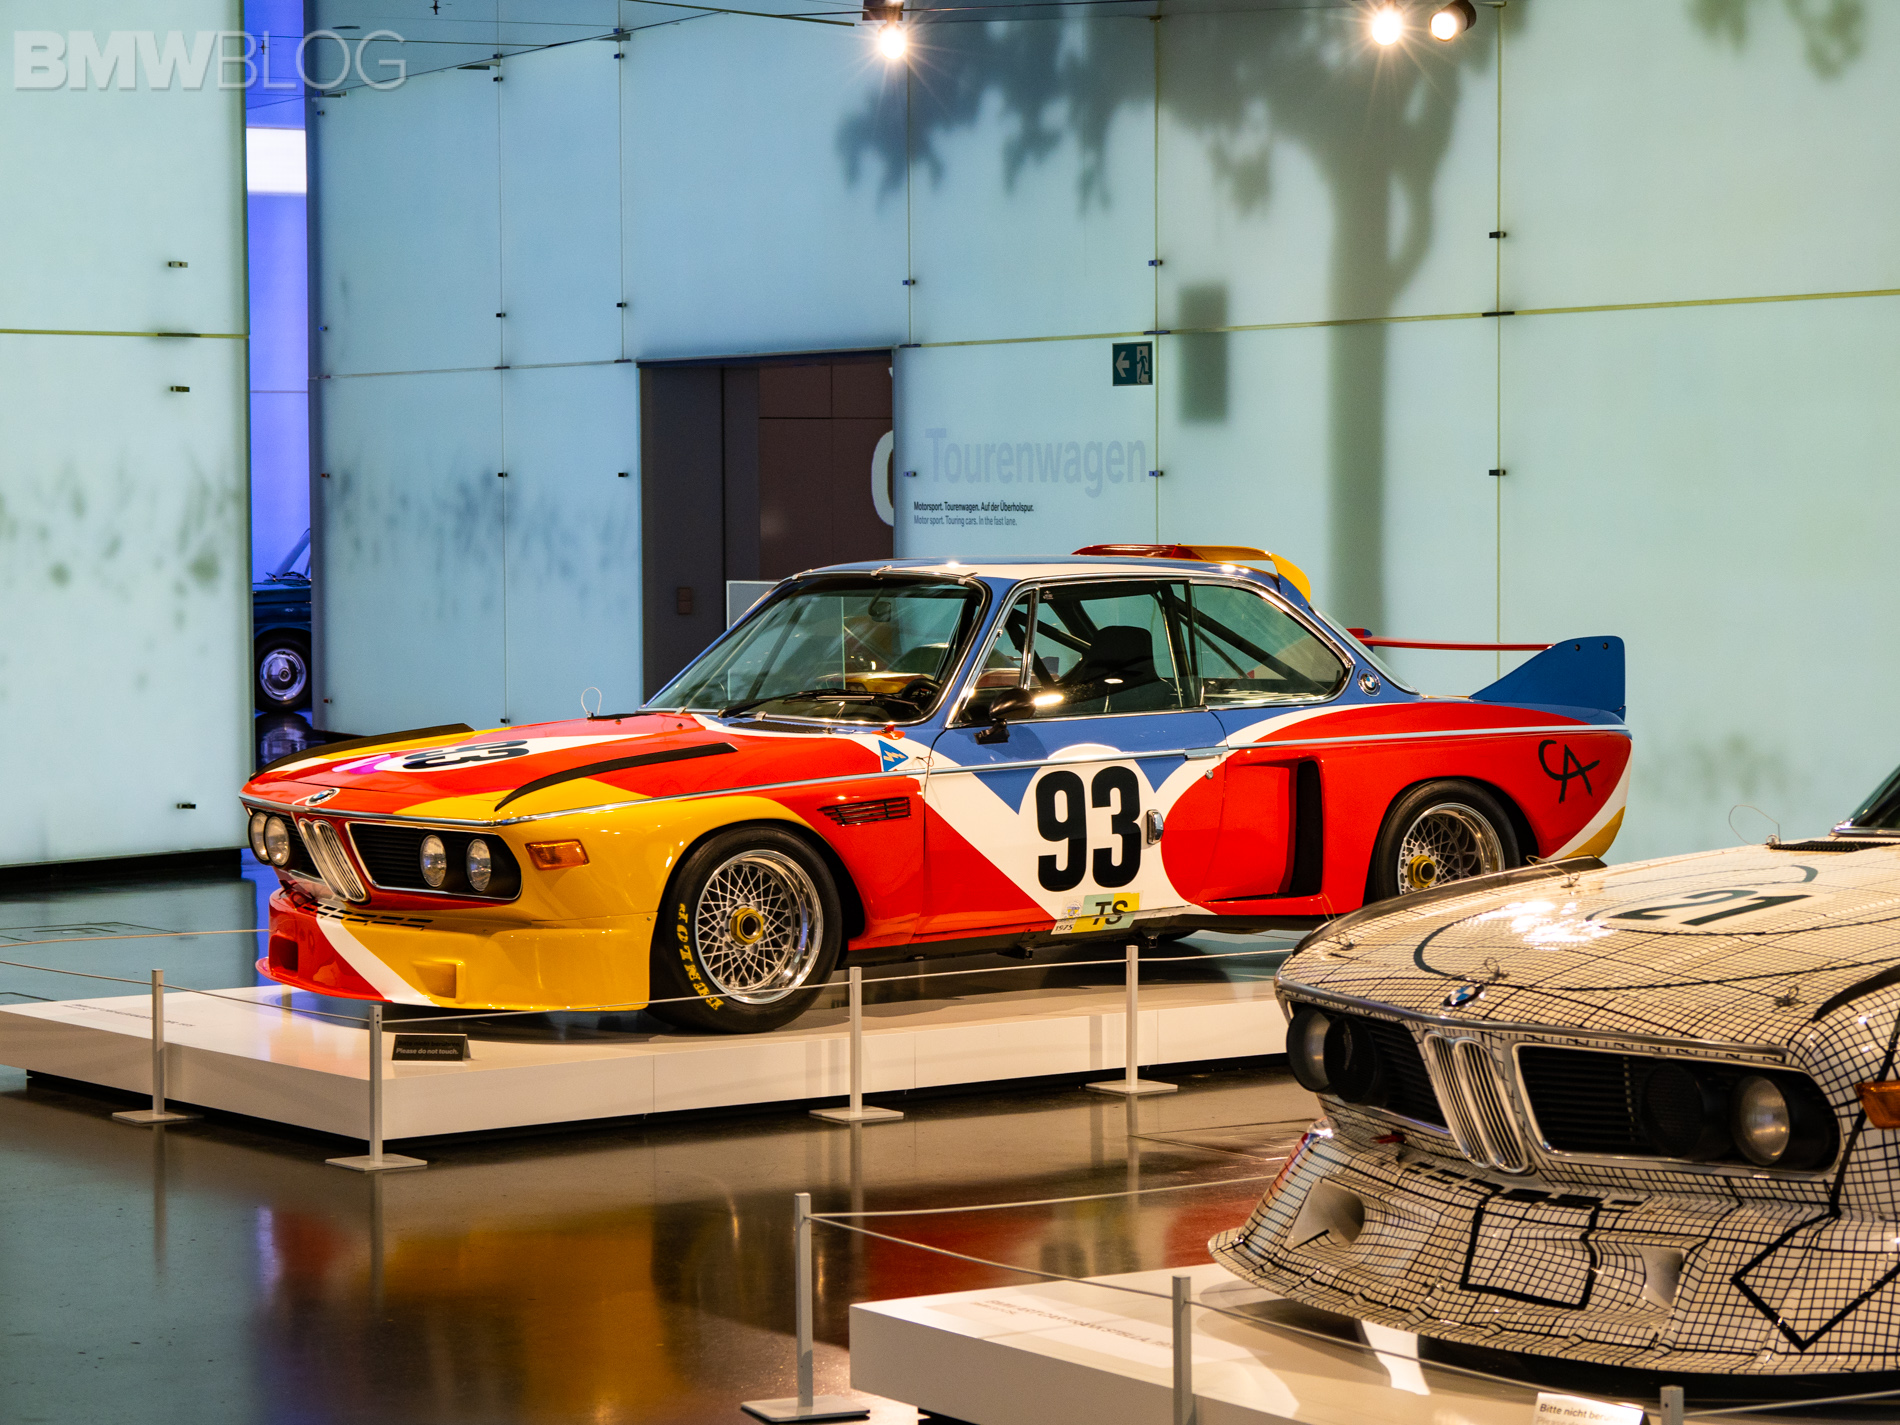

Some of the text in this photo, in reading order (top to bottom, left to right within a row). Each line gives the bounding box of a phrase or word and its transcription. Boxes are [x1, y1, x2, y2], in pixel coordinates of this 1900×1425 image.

[925, 427, 1146, 498] Tourenwagen
[914, 499, 1034, 513] Motorsport. Tourenwagen. Auf der Überholspur.
[914, 515, 1017, 527] Motor sport. Touring cars. In the fast lane.
[1035, 766, 1142, 892] 93
[1092, 900, 1128, 925] TS
[1607, 889, 1813, 926] 21
[1055, 924, 1073, 932] 1975
[677, 903, 724, 1010] DUNLOP
[1539, 1403, 1562, 1415] Bitte
[1564, 1408, 1587, 1418] nicht
